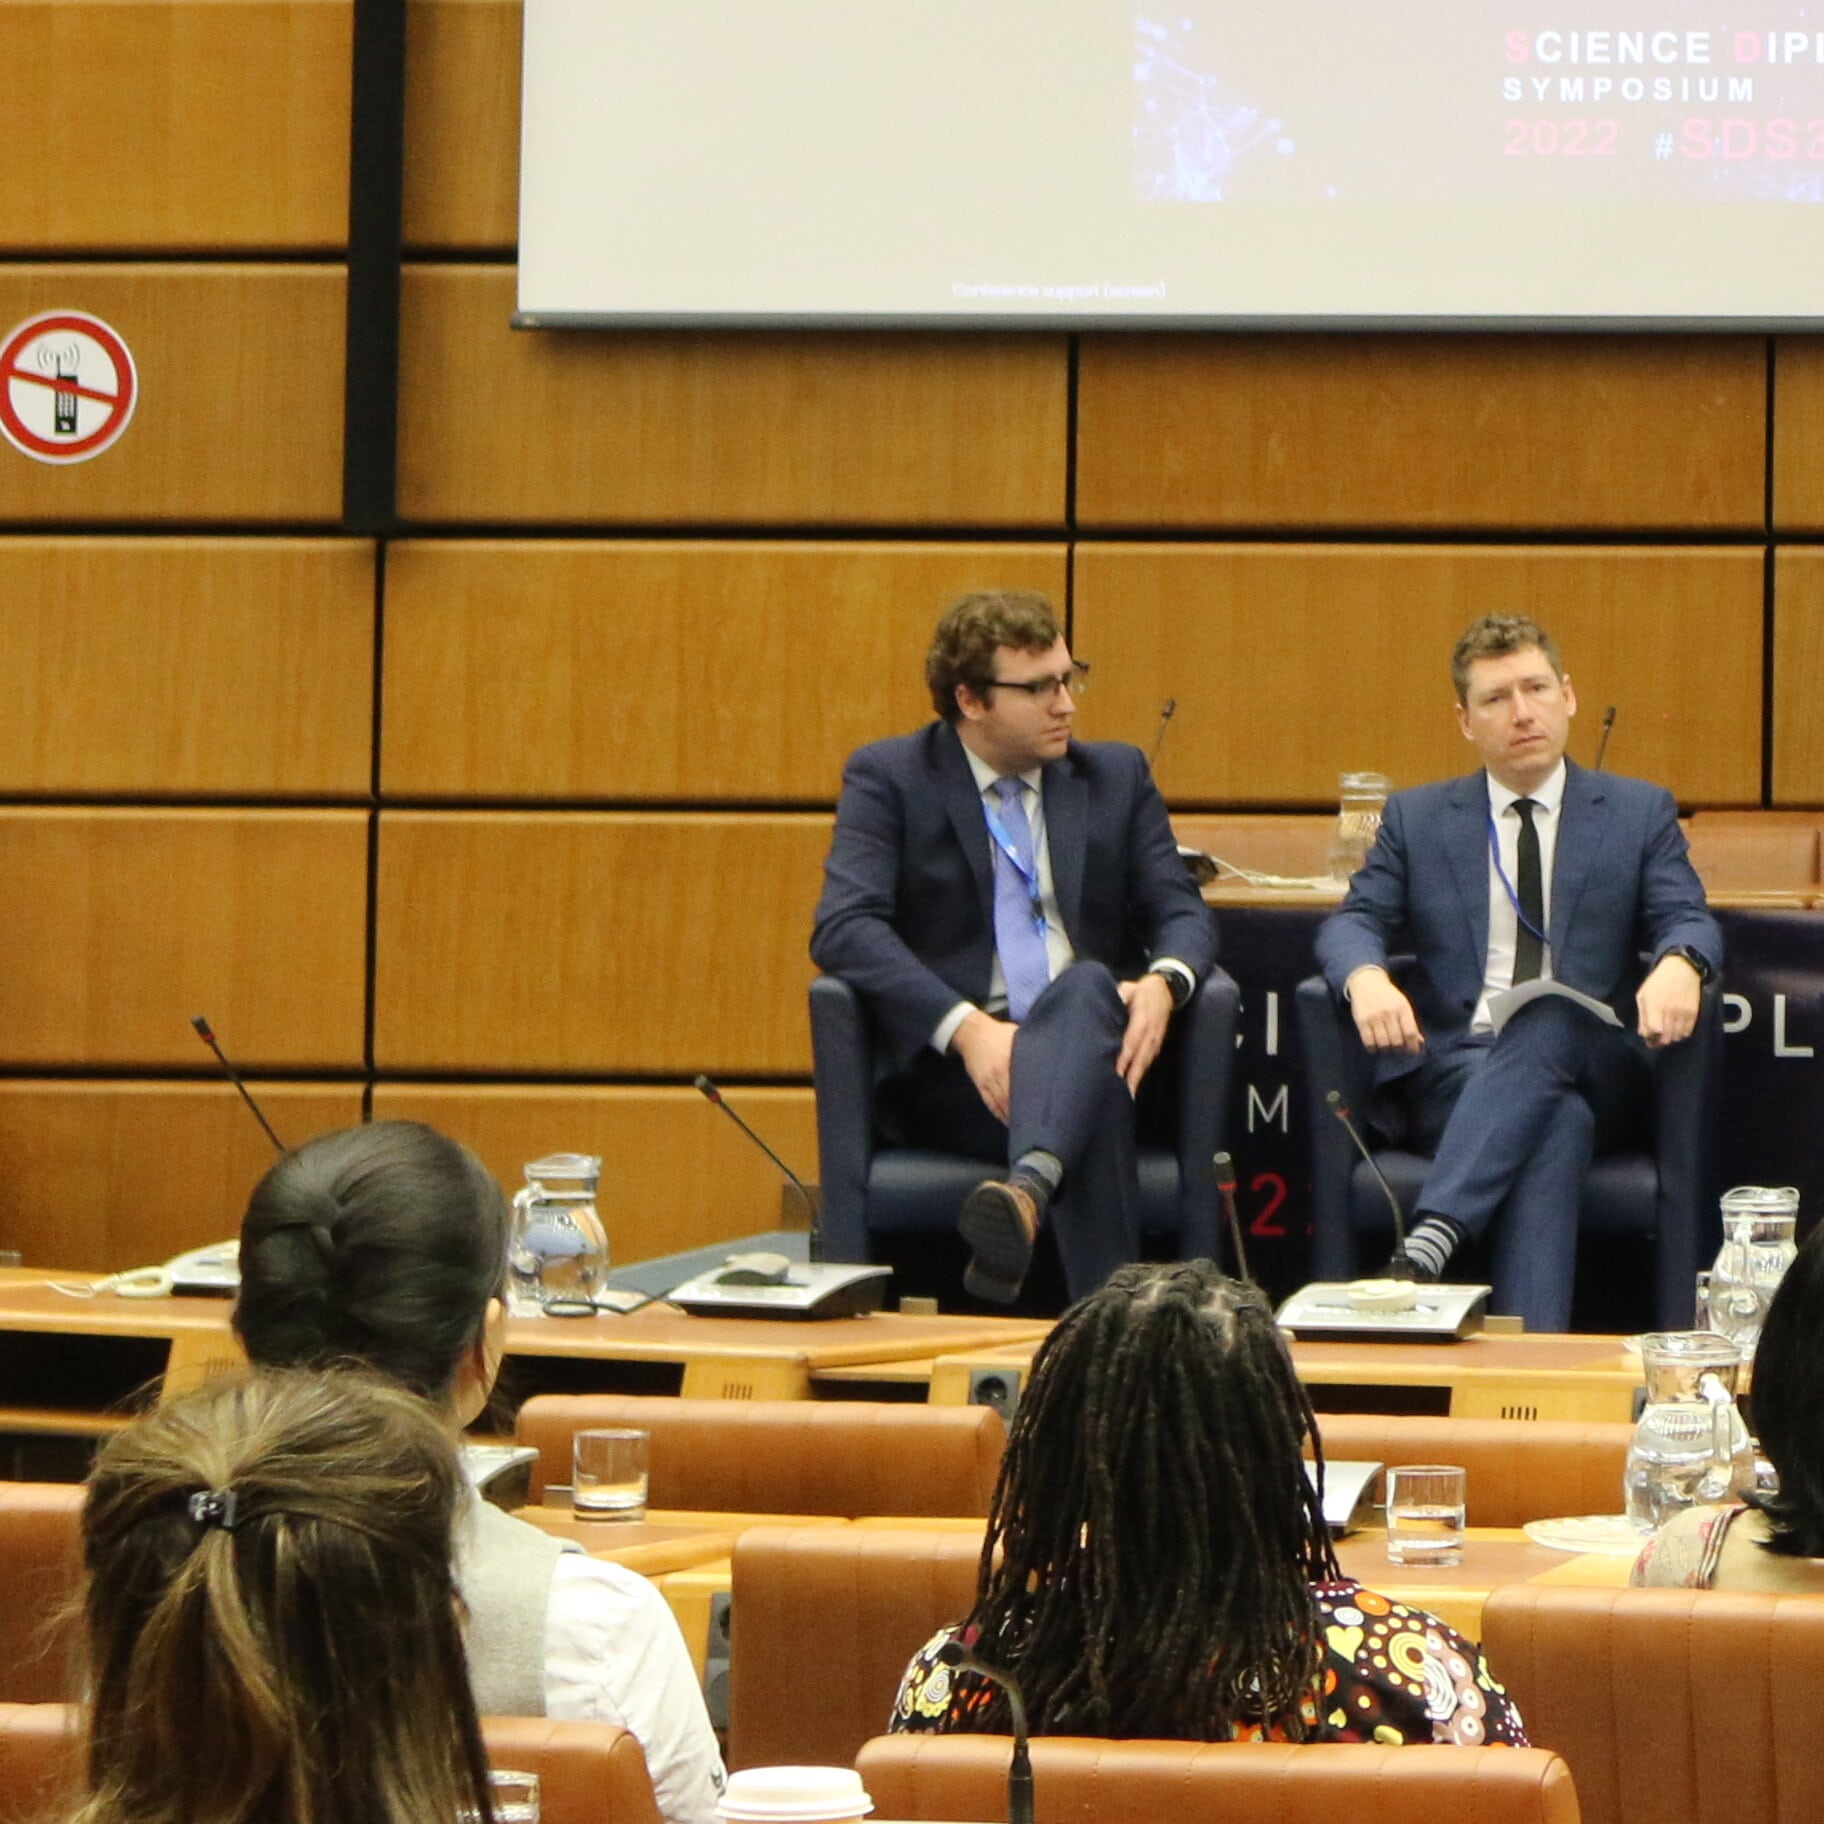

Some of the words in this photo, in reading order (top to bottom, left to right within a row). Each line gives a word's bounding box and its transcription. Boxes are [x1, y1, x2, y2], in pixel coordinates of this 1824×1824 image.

[1503, 31, 1713, 65] SCIENCE
[1503, 77, 1756, 103] SYMPOSIUM
[1502, 118, 1619, 157] 2022
